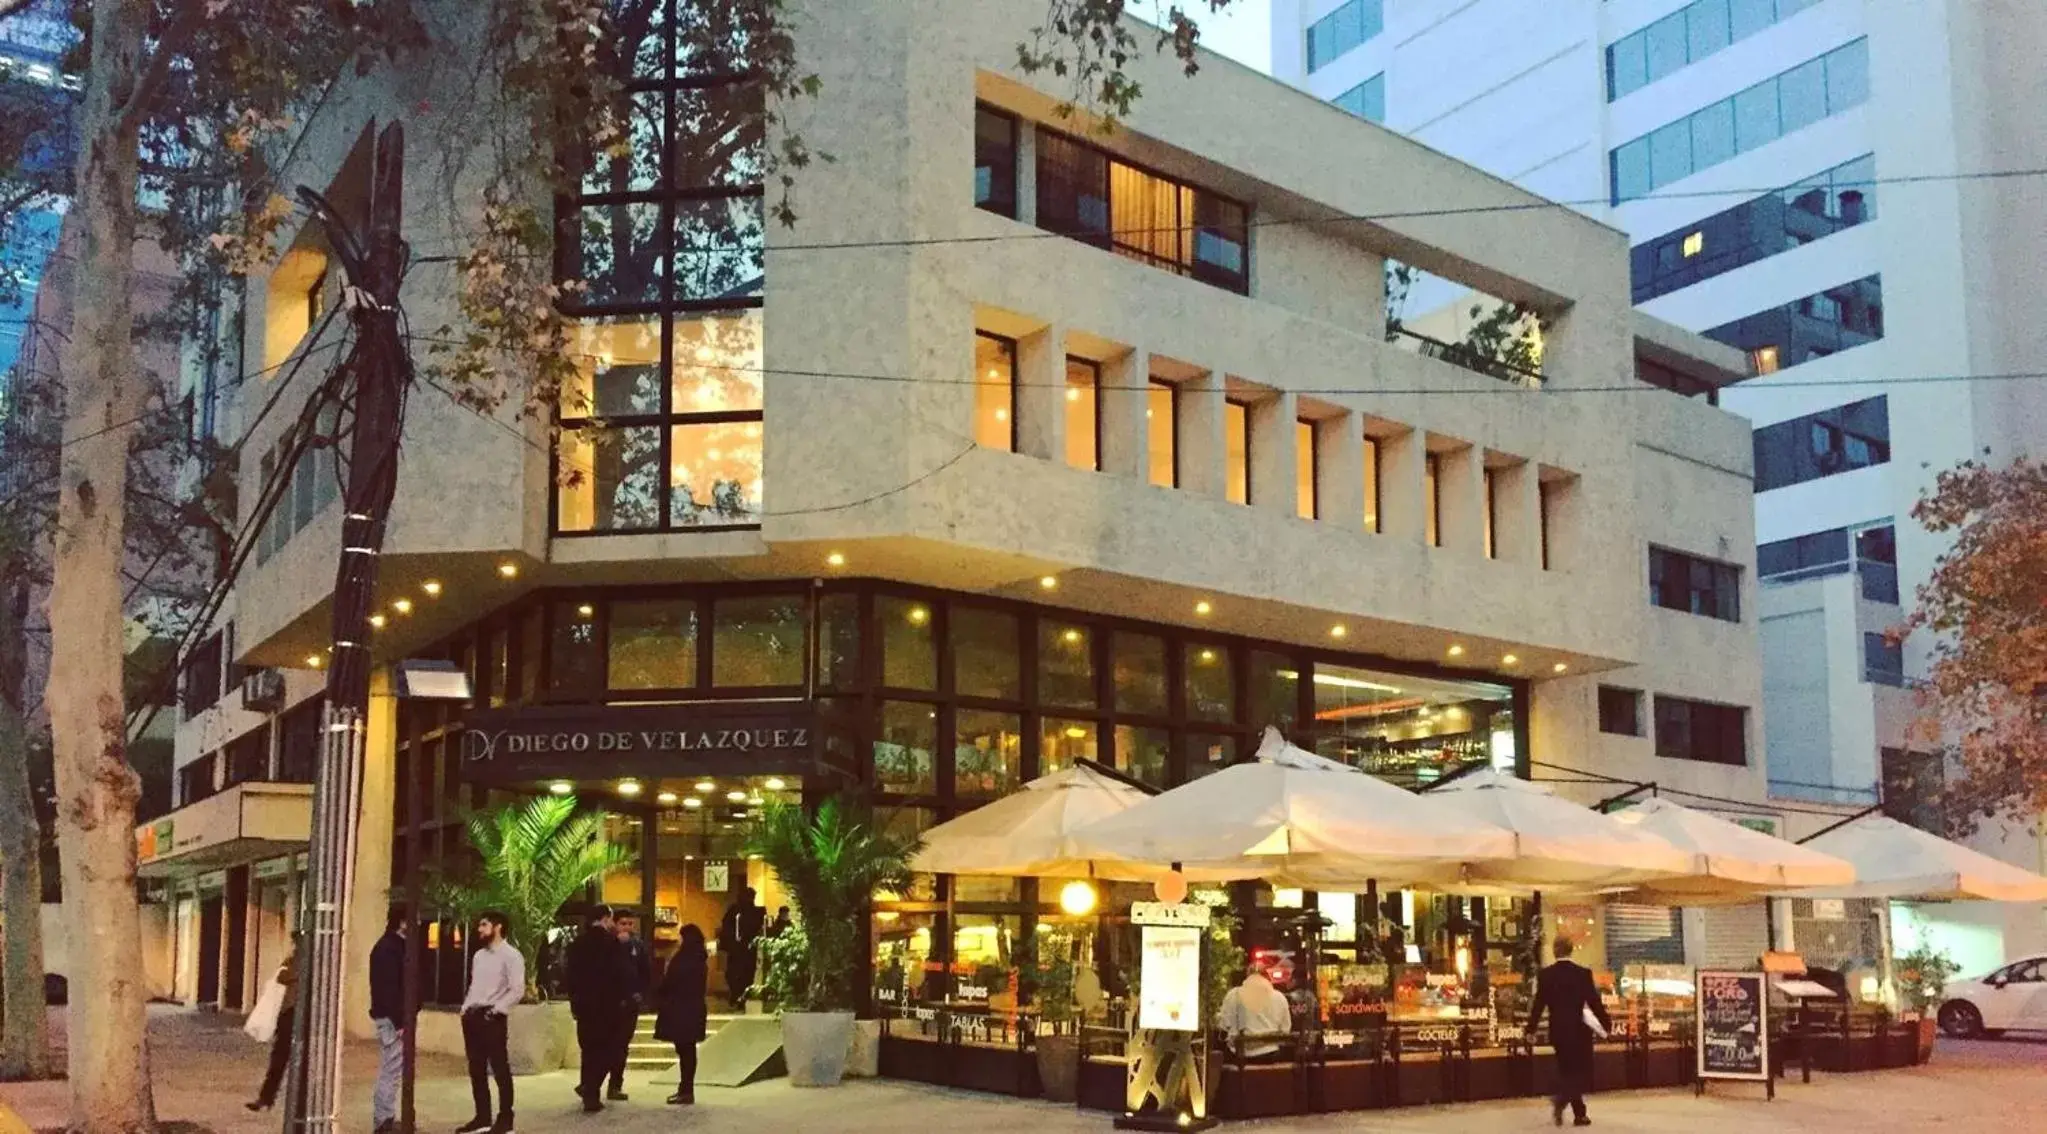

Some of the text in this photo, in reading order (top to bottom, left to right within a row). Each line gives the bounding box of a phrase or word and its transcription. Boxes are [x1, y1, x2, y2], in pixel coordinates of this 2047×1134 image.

[508, 732, 589, 753] DIEGO
[598, 732, 632, 750] DE
[641, 728, 808, 751] VELAZQUEZ
[878, 988, 896, 1001] BAR
[958, 983, 988, 1001] tapas
[1468, 1007, 1488, 1020] BAR
[950, 1014, 986, 1029] TABLAS
[1417, 1026, 1459, 1042] COCTELES
